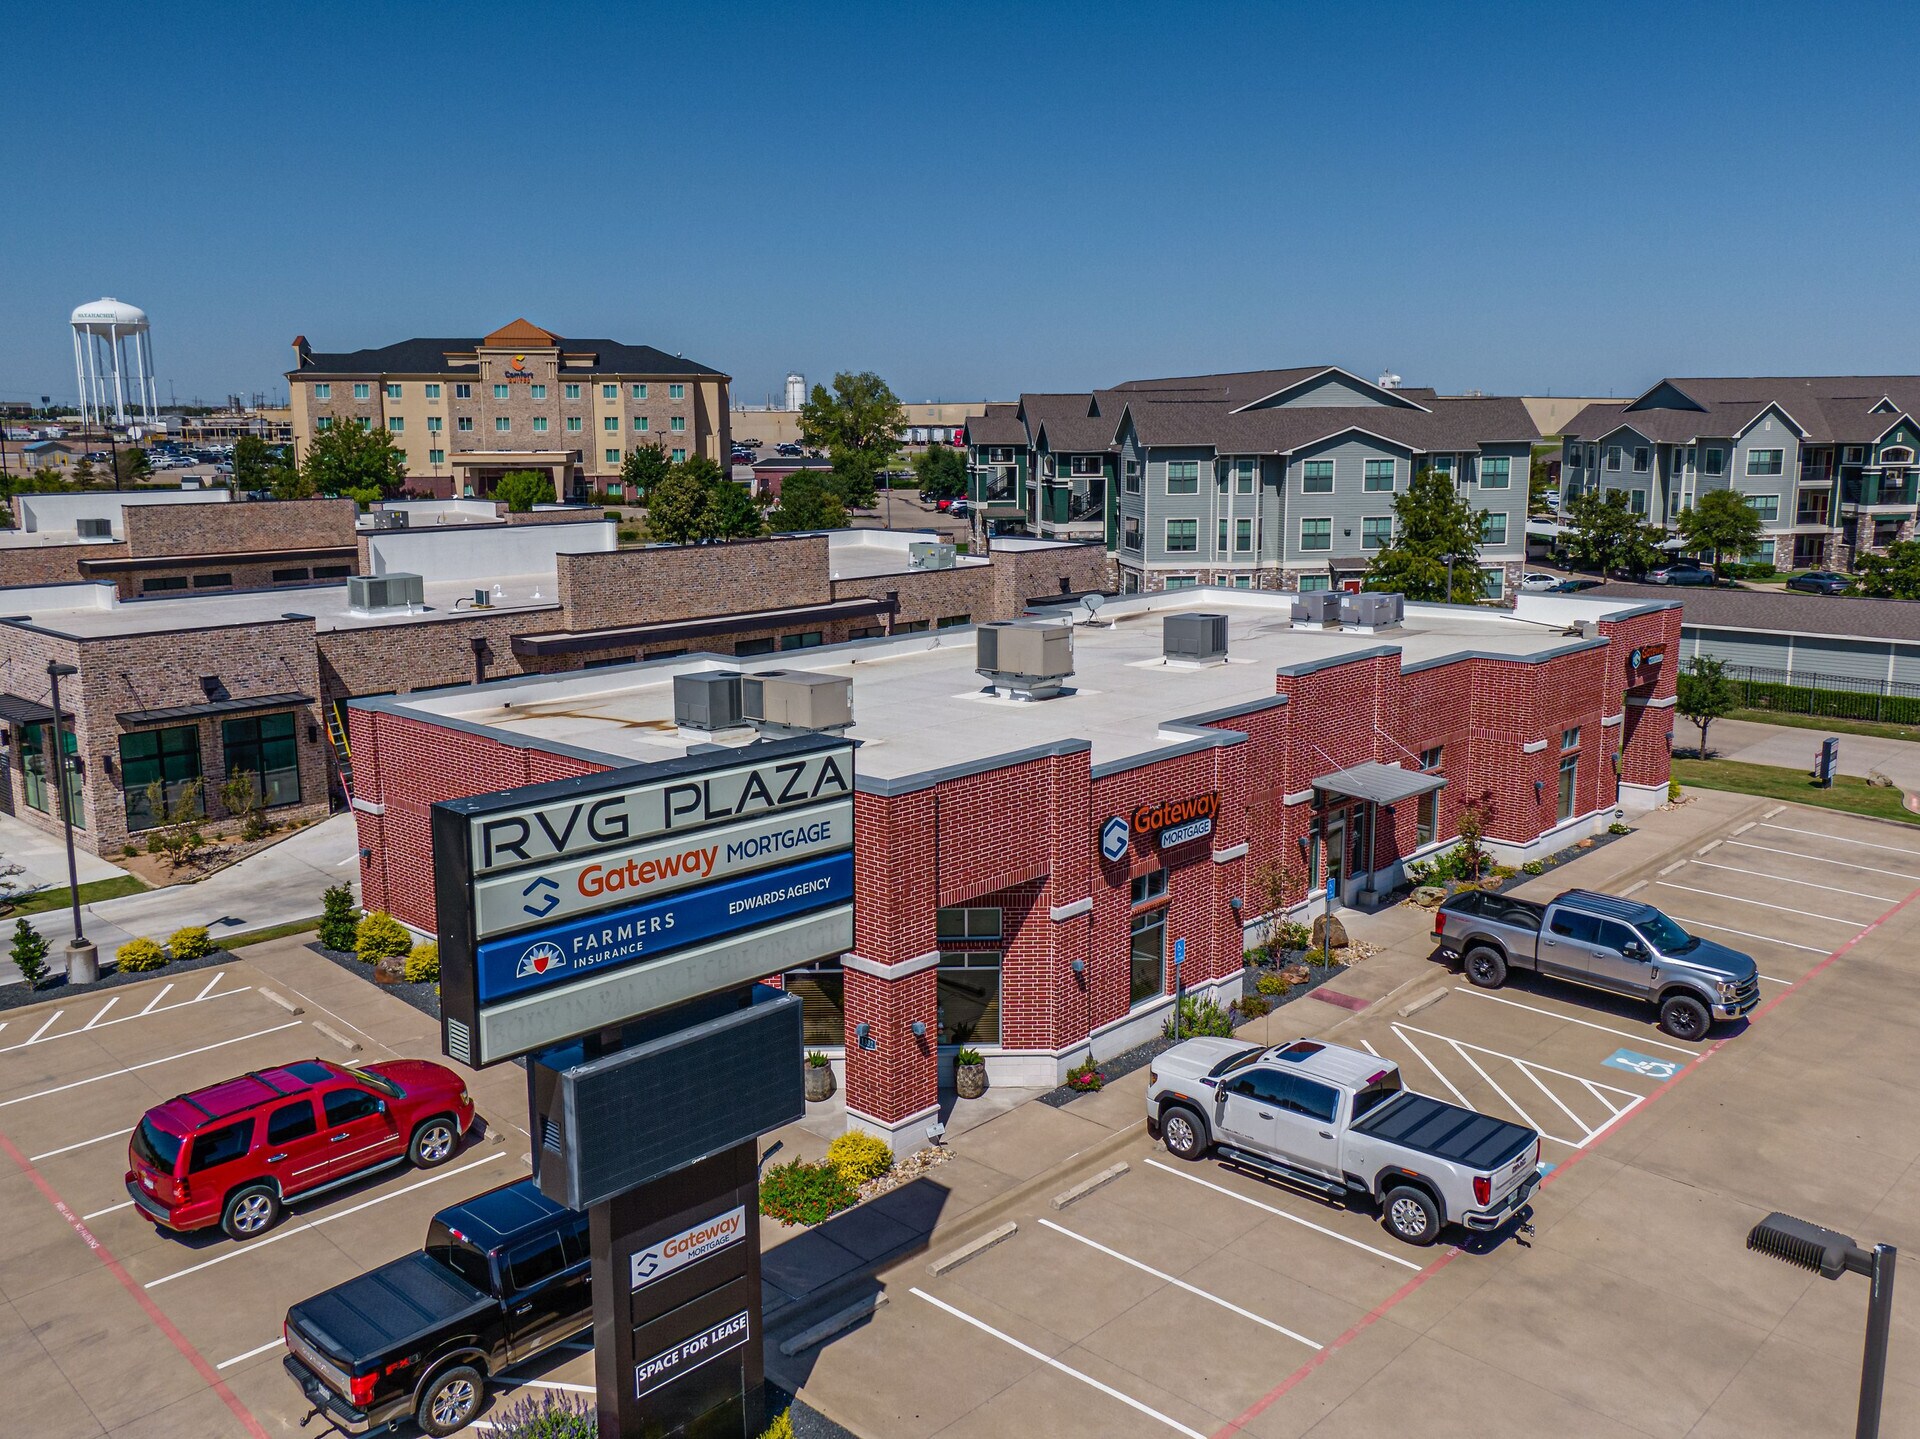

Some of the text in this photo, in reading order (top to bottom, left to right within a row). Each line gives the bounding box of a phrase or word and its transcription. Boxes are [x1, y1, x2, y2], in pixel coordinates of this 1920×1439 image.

[484, 755, 849, 868] RVG PLAZA
[1135, 792, 1220, 833] Gateway
[1163, 820, 1210, 846] MORTGAGE
[578, 820, 831, 898] Gateway MORTGAGE
[729, 876, 831, 915] EDWARDS AGENCY
[573, 912, 675, 954] FARMERS
[574, 941, 643, 969] INSURANCE
[663, 1213, 741, 1259] Gateway
[687, 1234, 730, 1260] MORTGAGE
[638, 1315, 747, 1383] SPACE FOR LEASE
